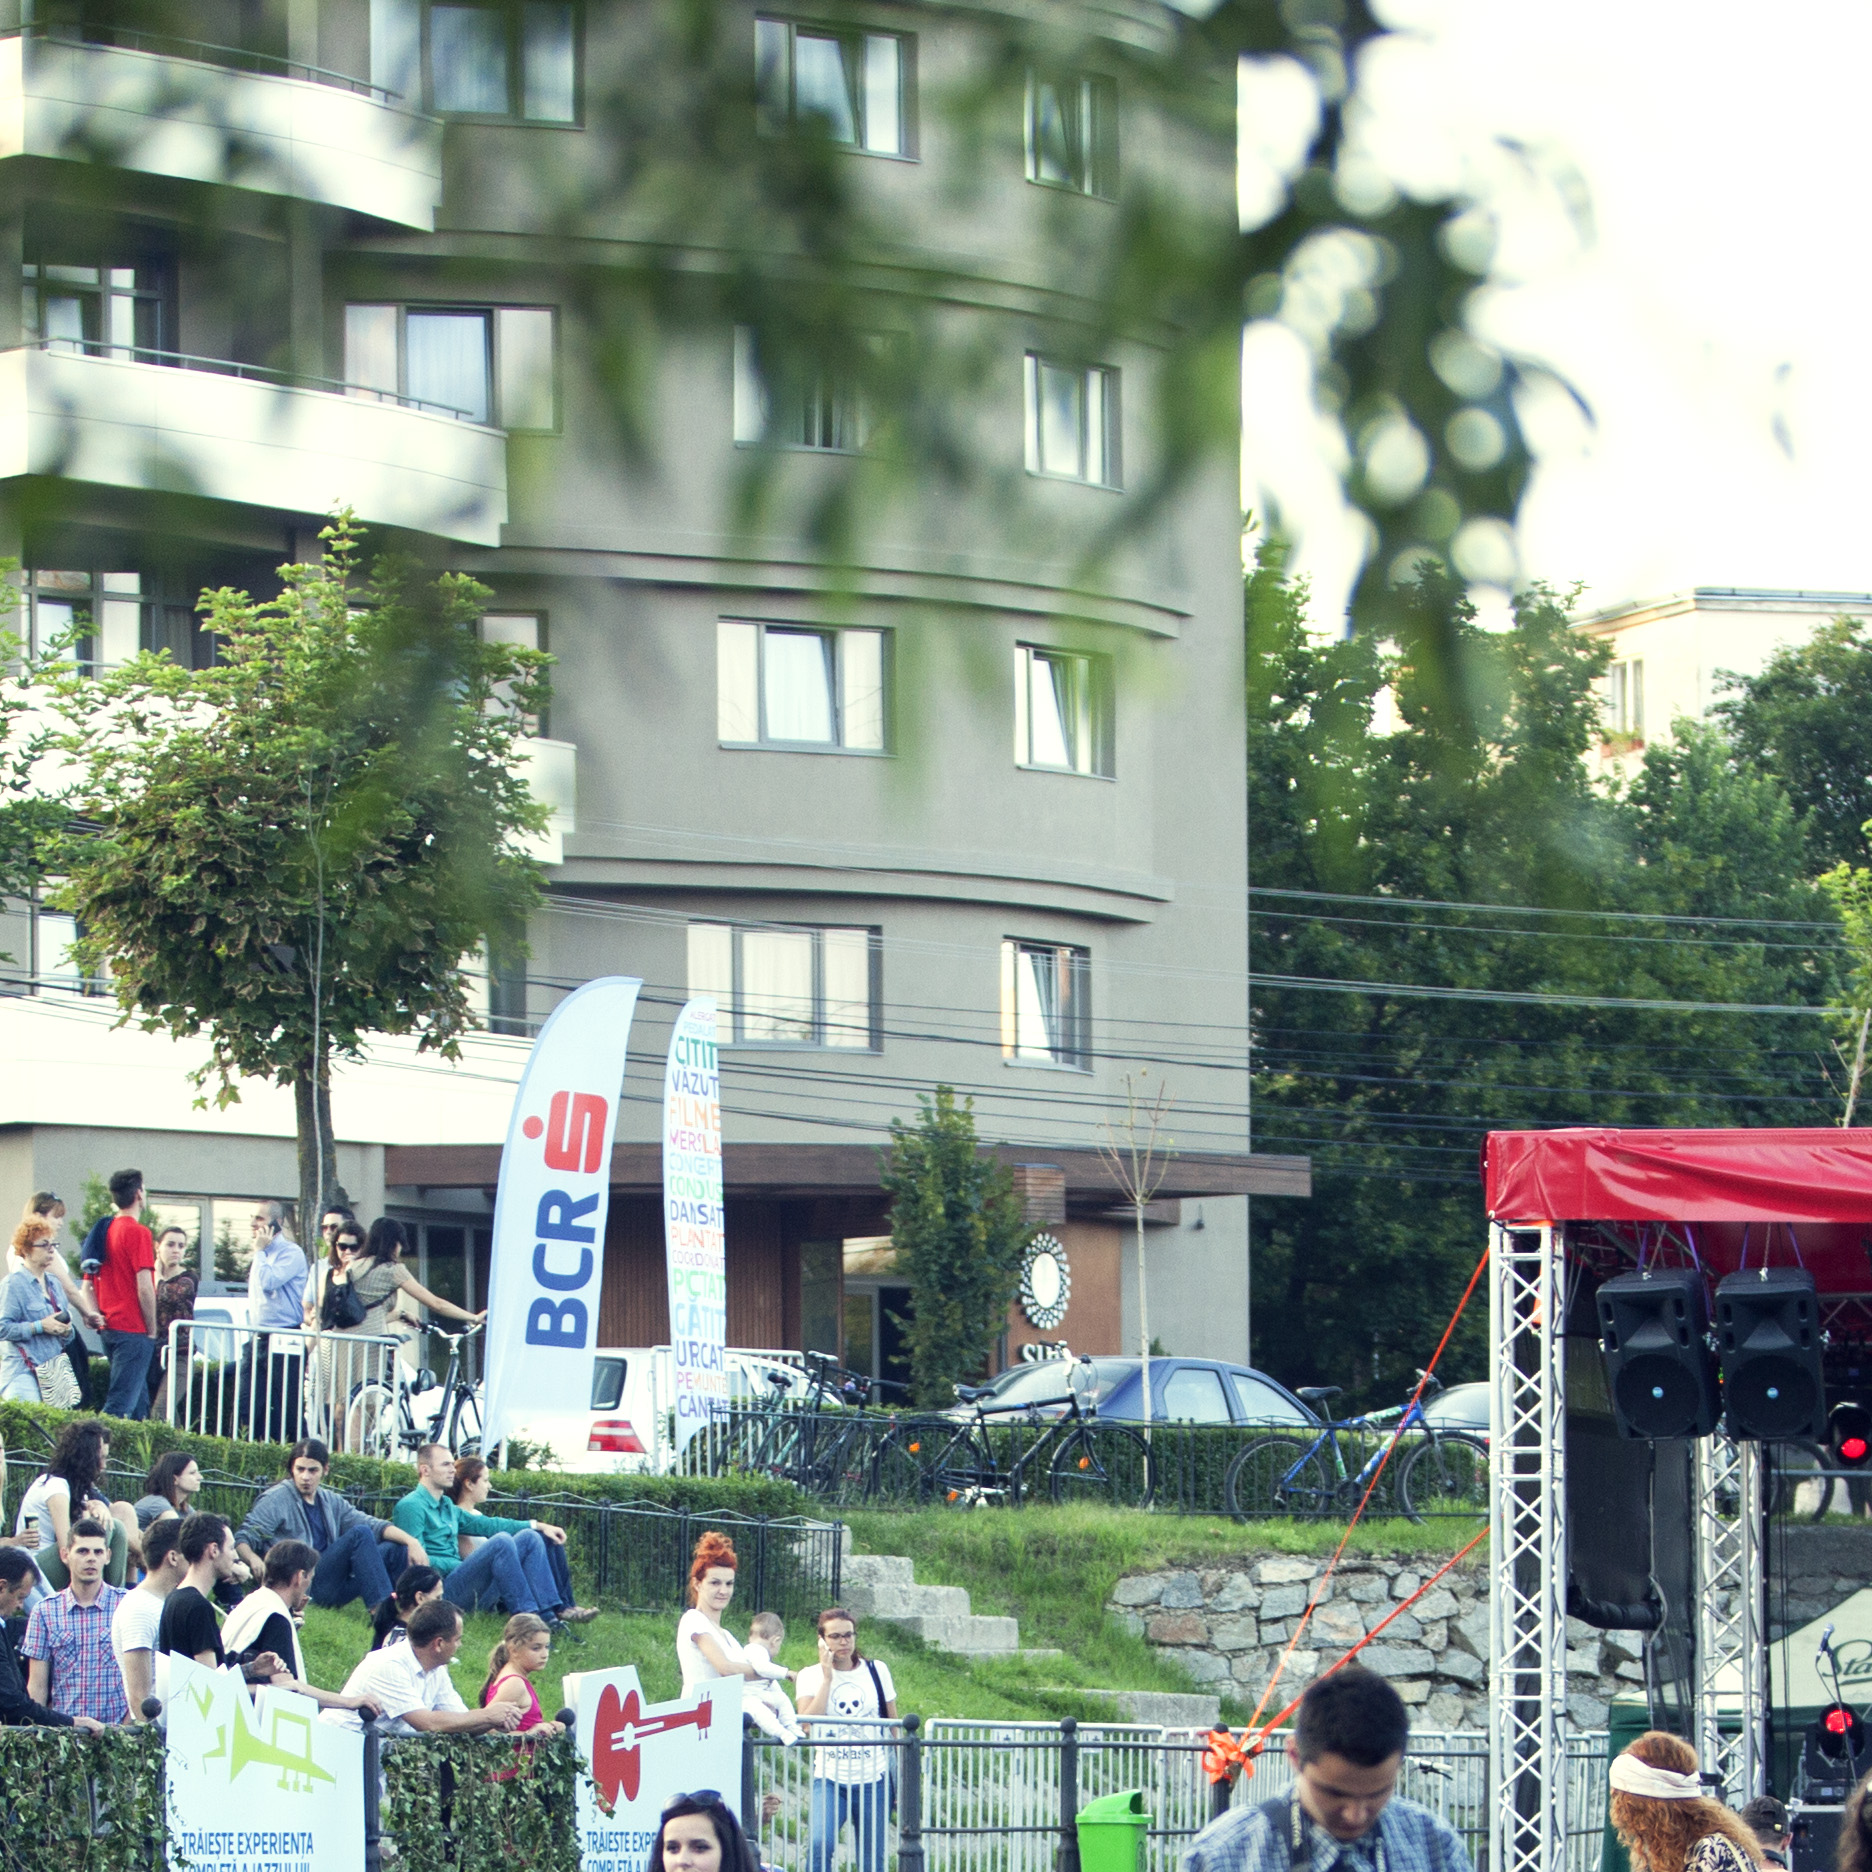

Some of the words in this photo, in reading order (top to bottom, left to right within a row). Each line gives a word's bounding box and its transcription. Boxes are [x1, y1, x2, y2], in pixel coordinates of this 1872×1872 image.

[676, 1035, 717, 1070] CITIT
[672, 1065, 719, 1098] VĂZUT
[670, 1175, 723, 1202] CONDUS
[670, 1199, 724, 1229] DANSAT
[525, 1189, 599, 1349] BCR
[676, 1340, 724, 1372] URCAT
[237, 1832, 314, 1859] EXPERIENȚA
